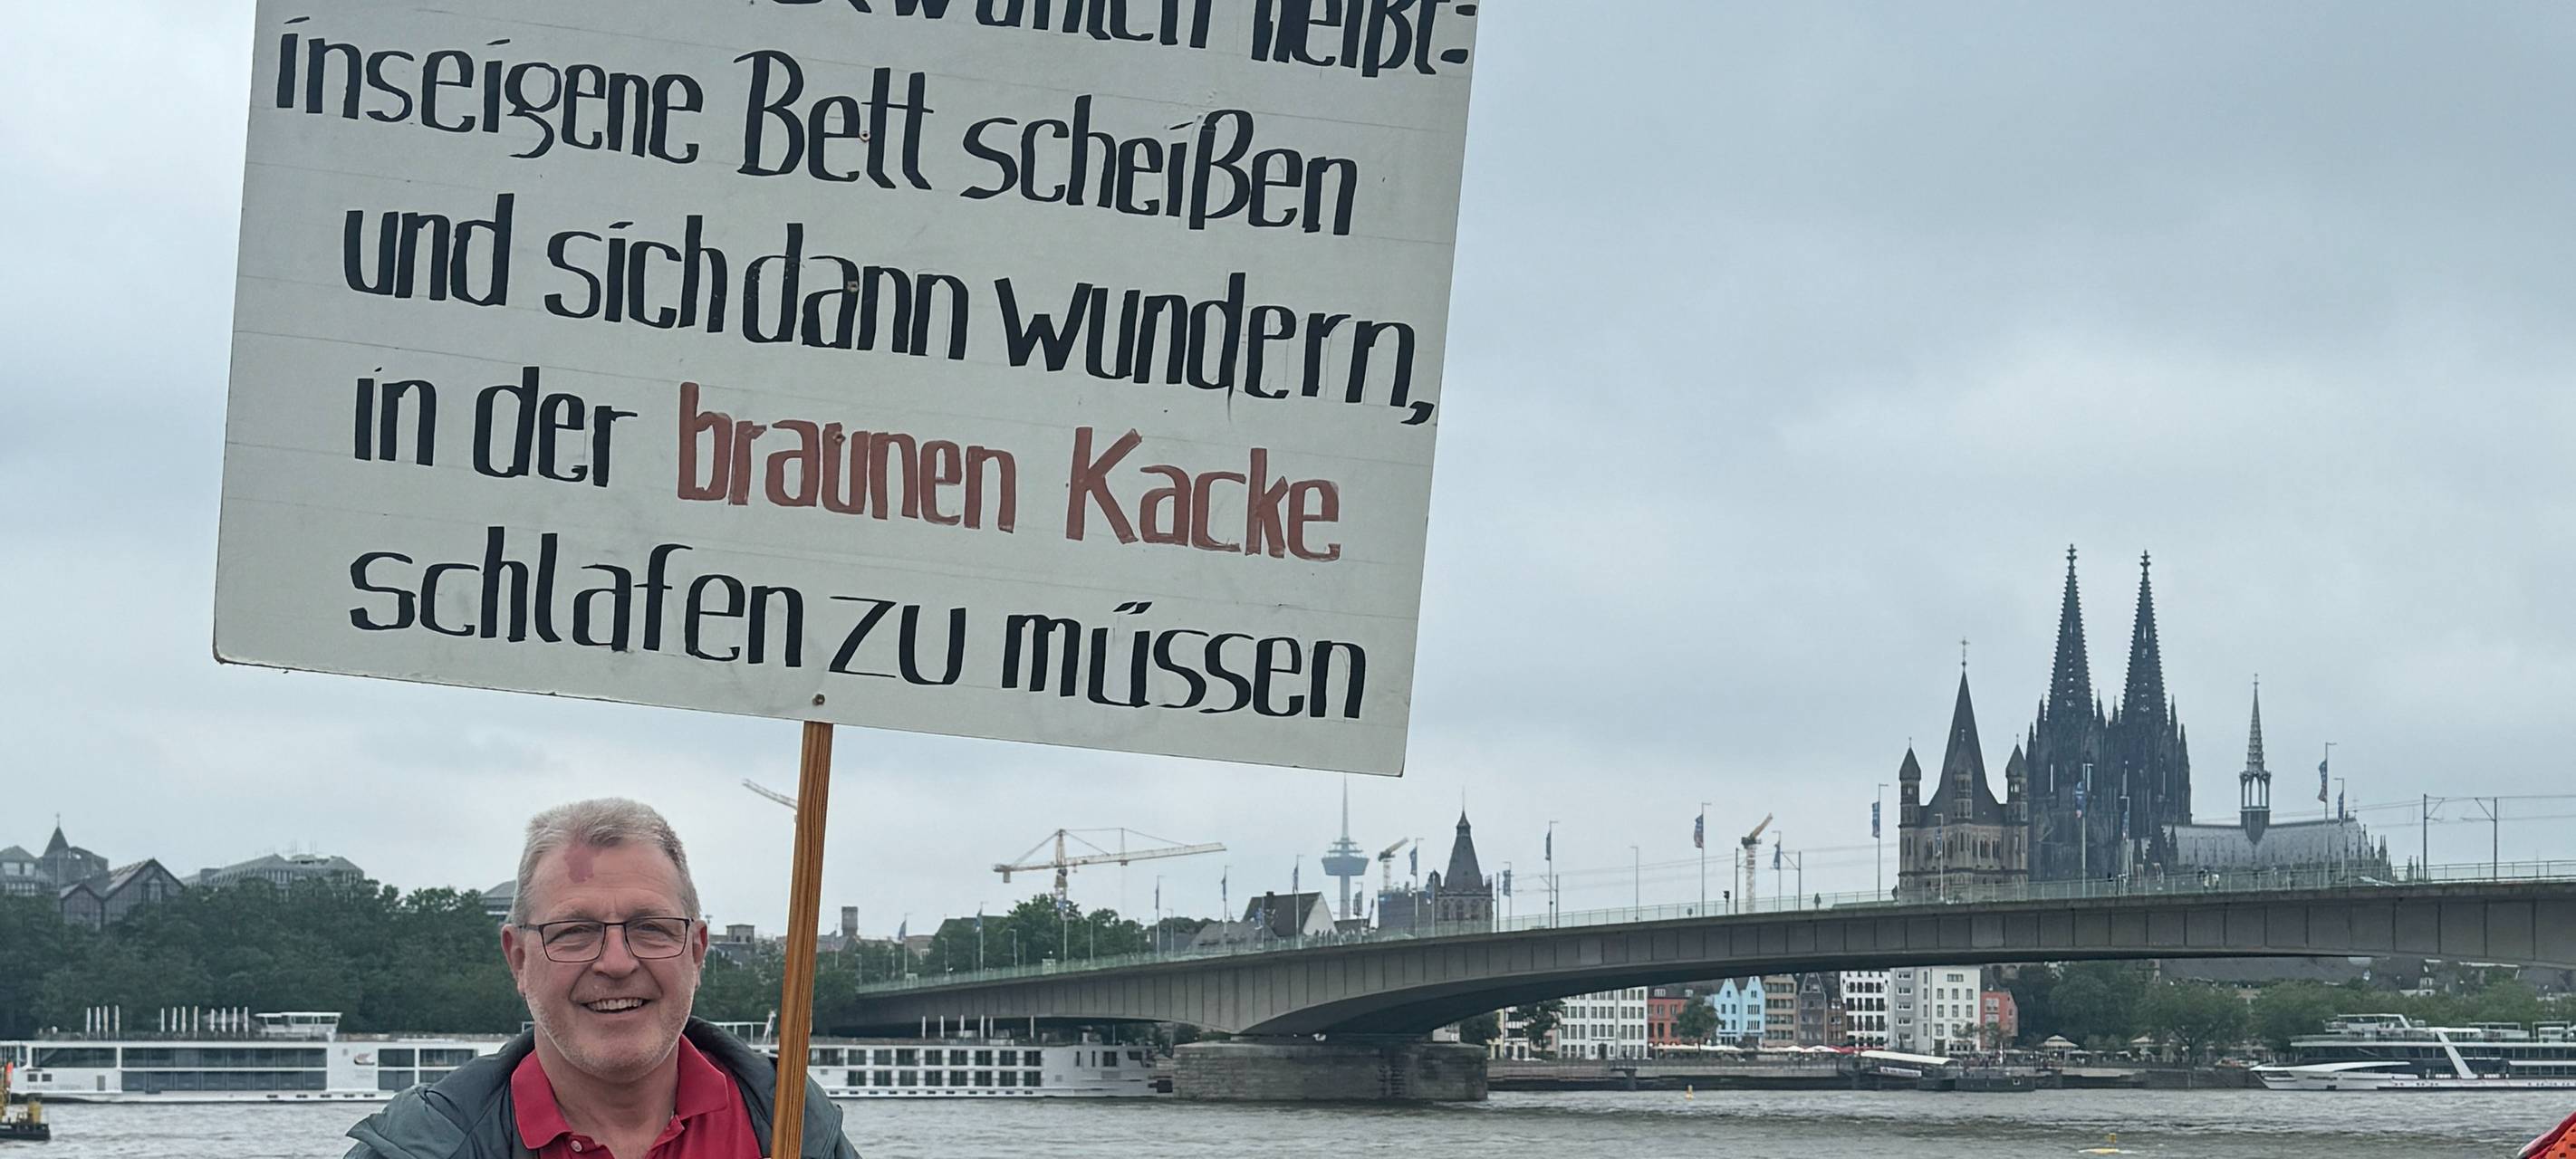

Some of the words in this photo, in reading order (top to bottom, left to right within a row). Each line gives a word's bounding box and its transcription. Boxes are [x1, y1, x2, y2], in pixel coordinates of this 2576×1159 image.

[733, 50, 935, 191] Bett
[960, 95, 1358, 236] scheißen
[343, 193, 515, 307] und
[543, 215, 728, 333] sich
[742, 223, 969, 360] dann
[994, 272, 1435, 426] wundern,
[354, 367, 437, 467] in
[473, 366, 639, 488] der
[678, 381, 1016, 534] braunen
[1066, 426, 1341, 562] Kacke
[349, 526, 803, 668] schlafen
[828, 596, 966, 686] zu
[1001, 601, 1367, 719] müssen
